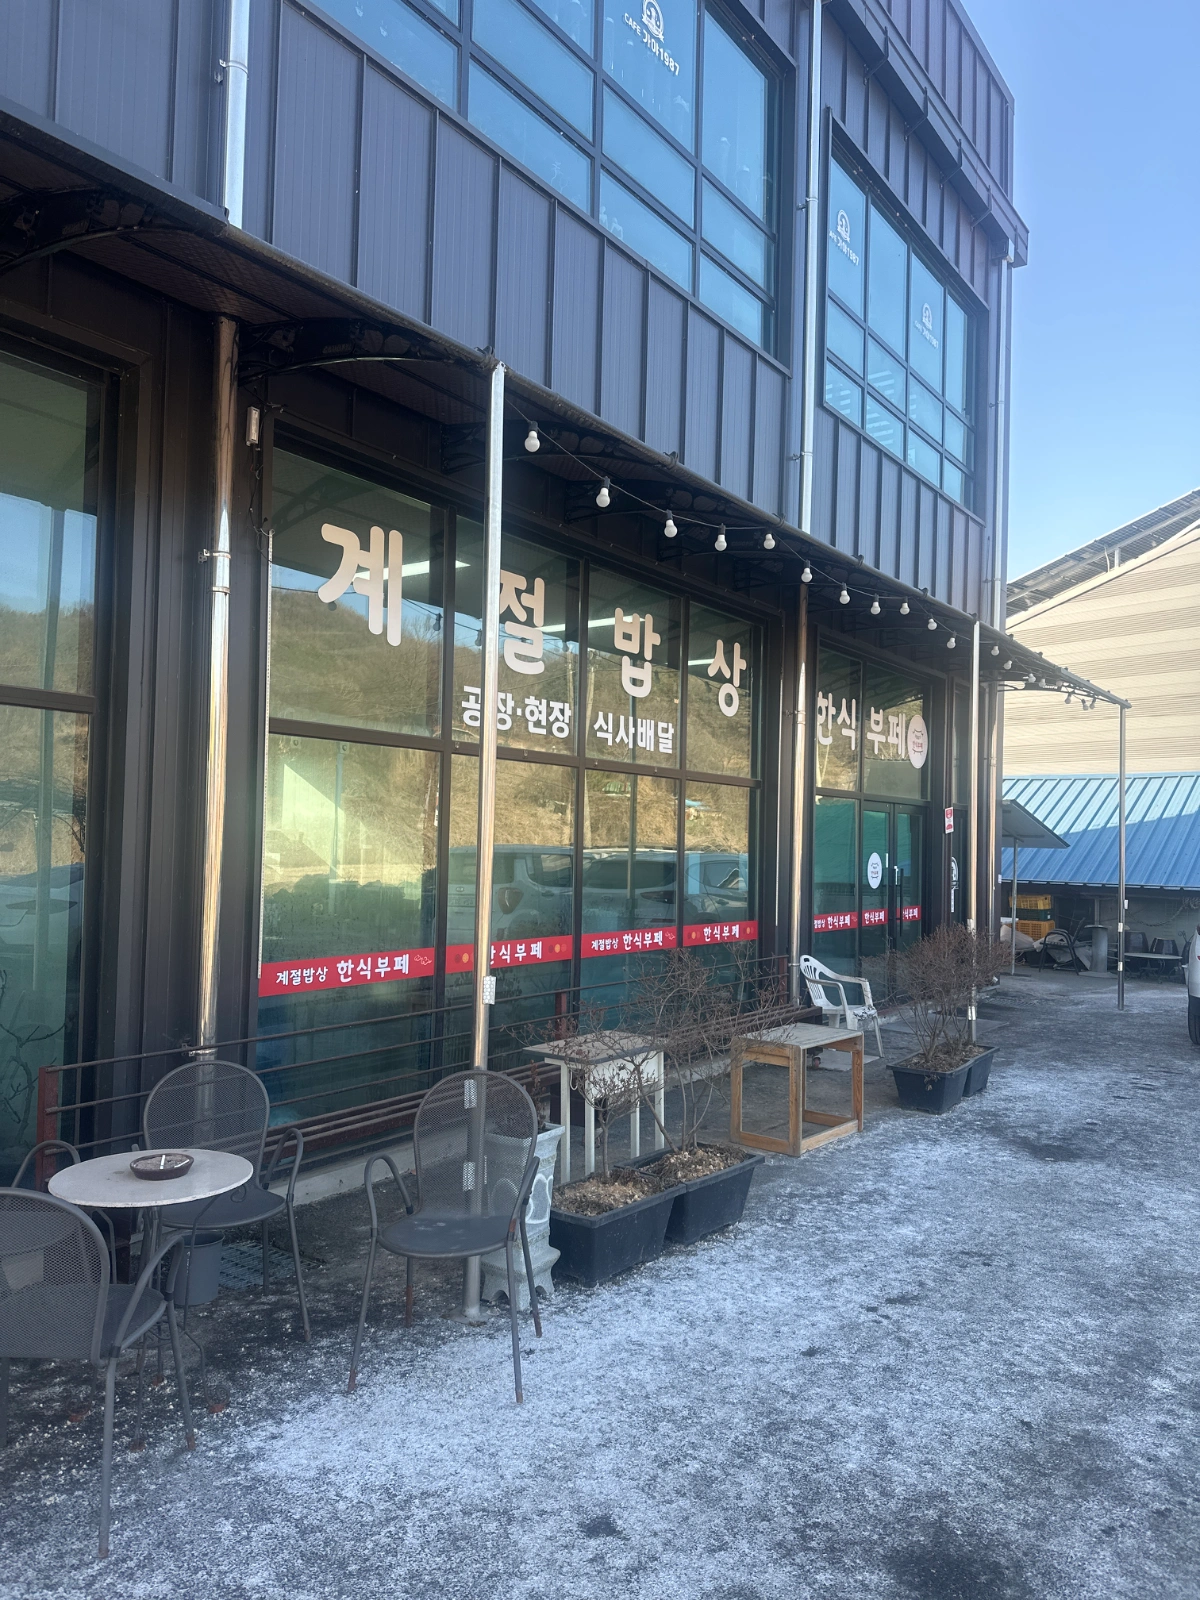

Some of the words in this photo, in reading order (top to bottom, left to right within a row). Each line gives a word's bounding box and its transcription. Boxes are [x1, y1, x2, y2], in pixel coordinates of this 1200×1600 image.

[624, 12, 641, 36] CAFE
[642, 28, 680, 76] 가야1987
[817, 691, 856, 751] 한식
[593, 711, 675, 754] 식사배달
[827, 914, 851, 929] 한식부페
[864, 910, 885, 924] 한식부페
[902, 907, 919, 920] 식부페
[591, 937, 619, 951] 계절밥상
[622, 930, 664, 951] 한식부페
[703, 924, 740, 942] 한식부페
[276, 966, 329, 986] 계절밥상
[336, 953, 410, 983] 한식부페
